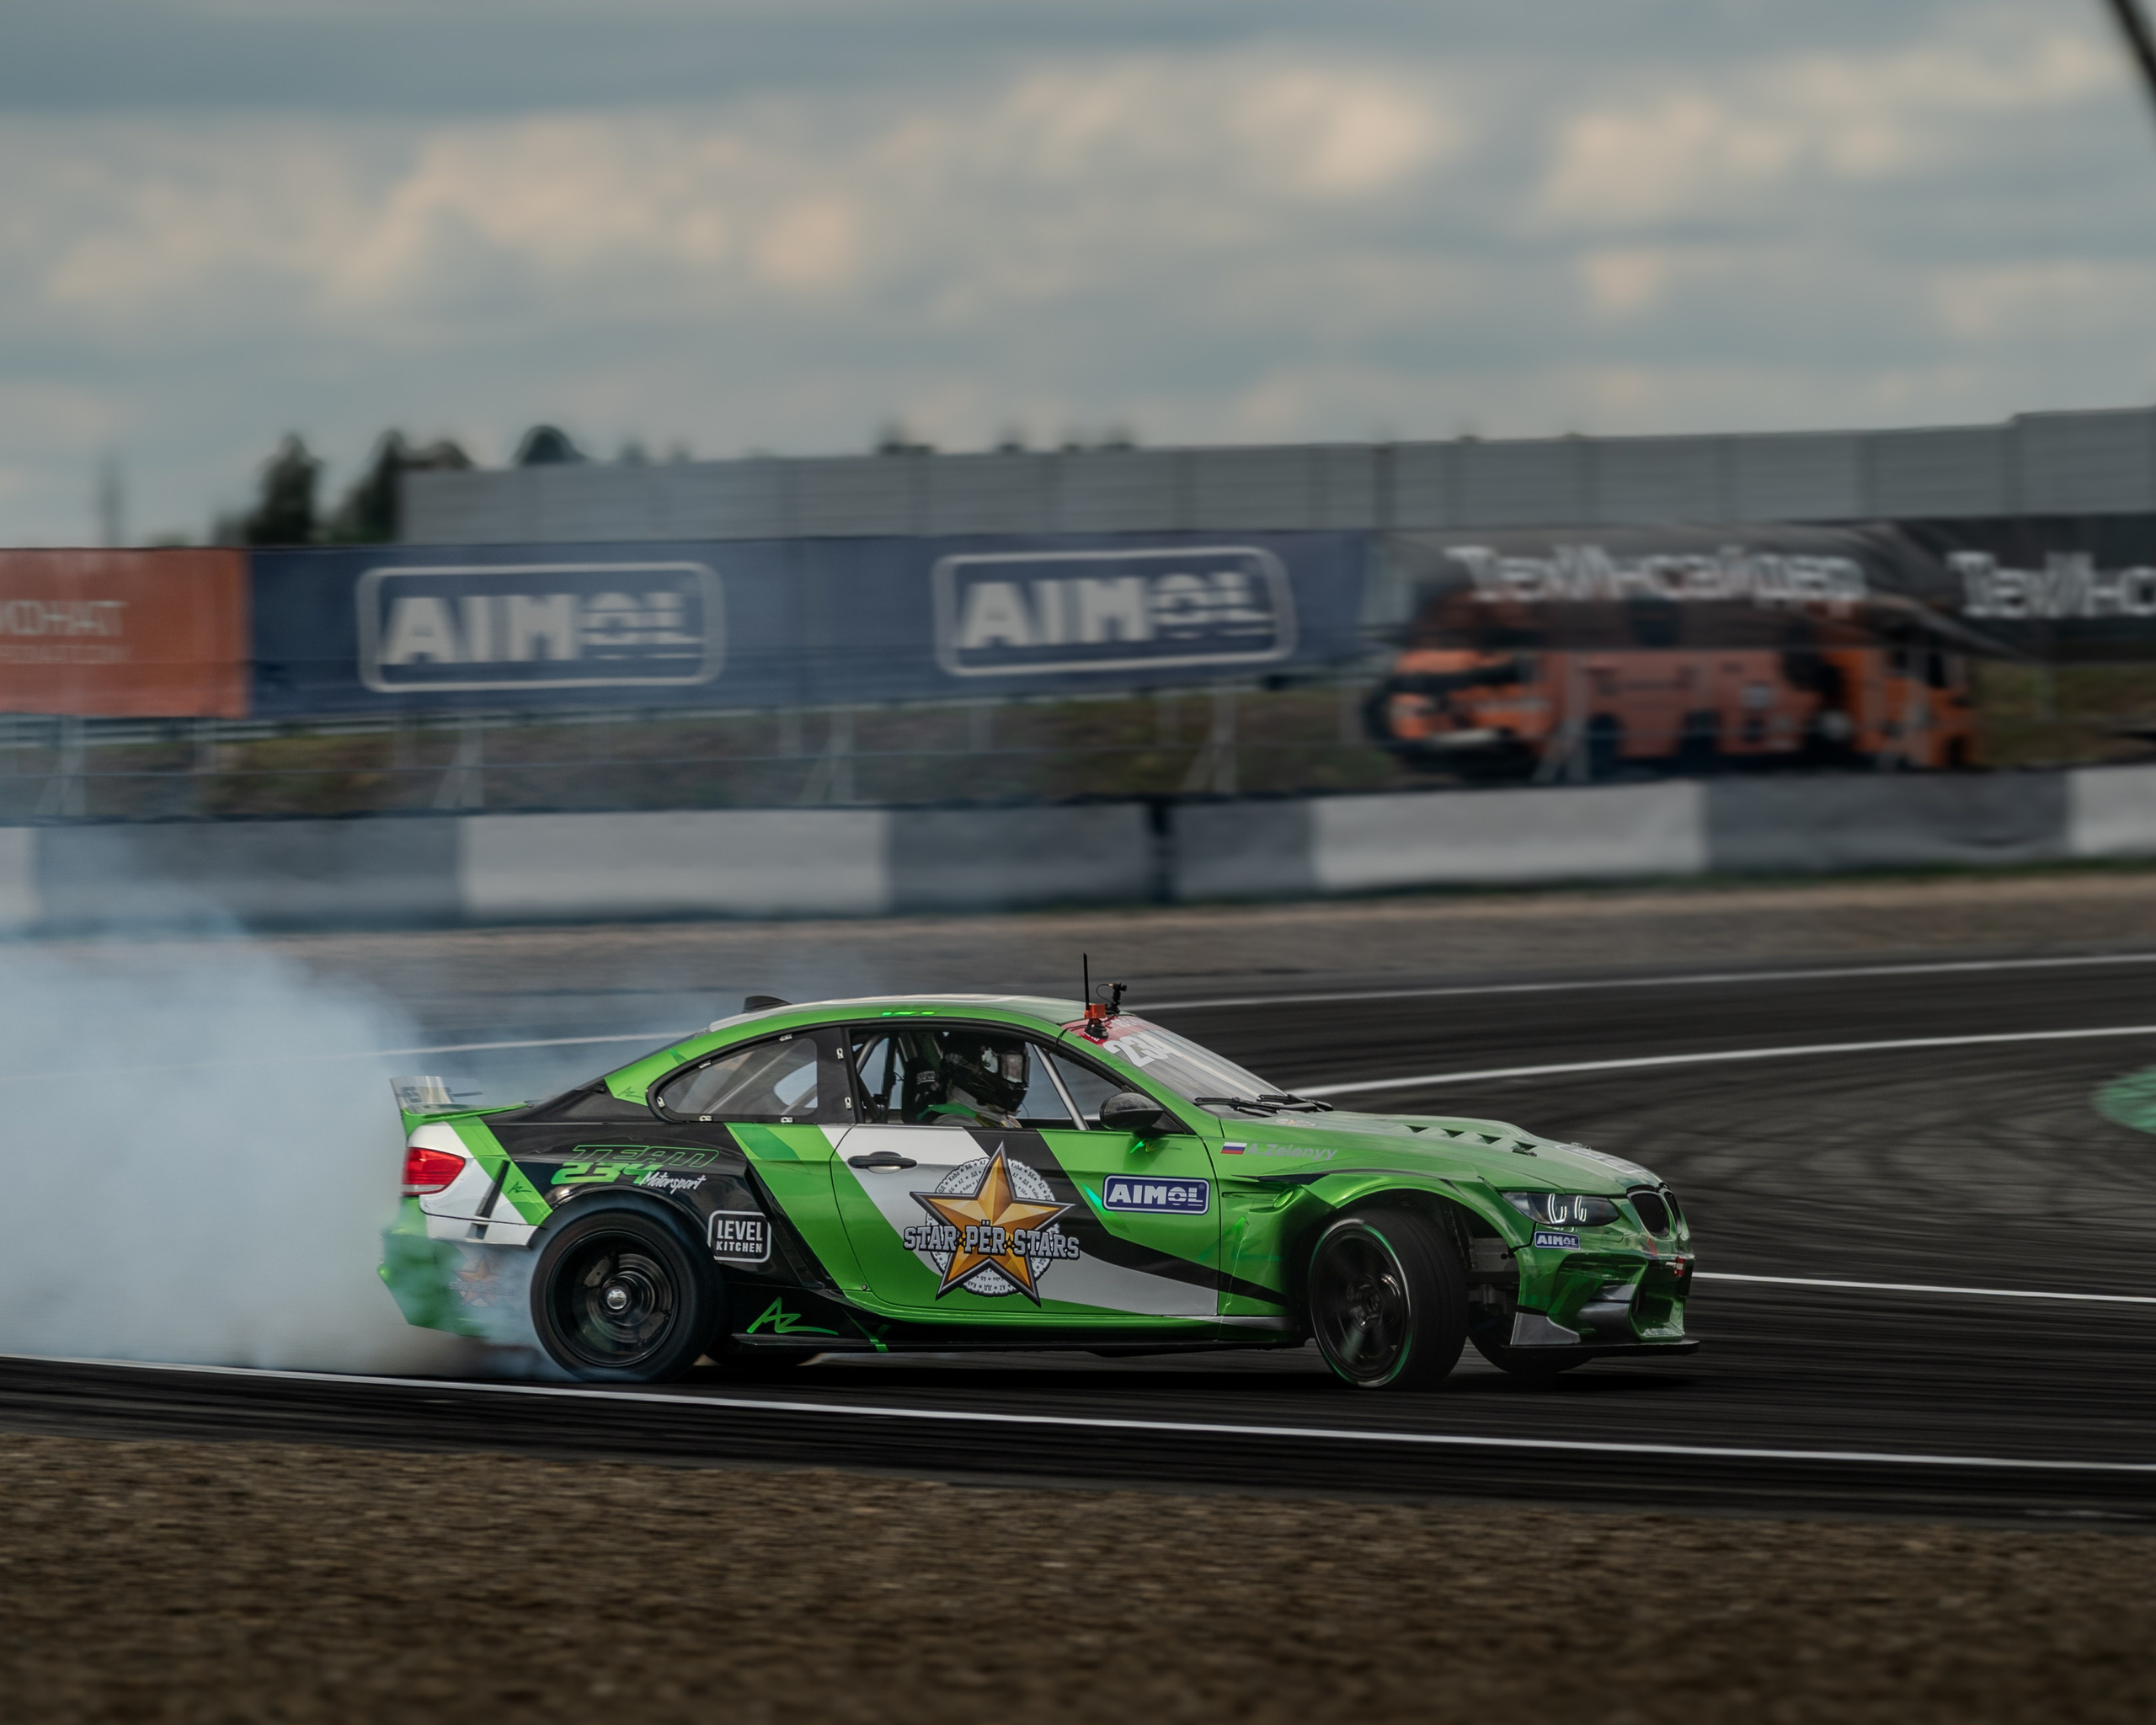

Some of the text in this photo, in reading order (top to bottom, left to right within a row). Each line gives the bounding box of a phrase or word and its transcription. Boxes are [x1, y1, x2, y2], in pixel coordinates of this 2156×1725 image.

[1444, 544, 1868, 618] ТехИнсайдер
[953, 571, 1278, 649] AIMOL
[378, 591, 704, 665] AIMOL
[568, 1145, 719, 1168] TEAM
[1246, 1143, 1338, 1161] A.Zelenyy
[551, 1162, 664, 1185] 234
[639, 1171, 707, 1195] Motorsport
[1107, 1183, 1203, 1207] AIMOL
[717, 1220, 763, 1242] LEVEL
[903, 1226, 958, 1252] STAR
[1011, 1227, 1081, 1259] STARS
[1536, 1234, 1578, 1247] AIMOL
[716, 1241, 762, 1253] KITCHEN
